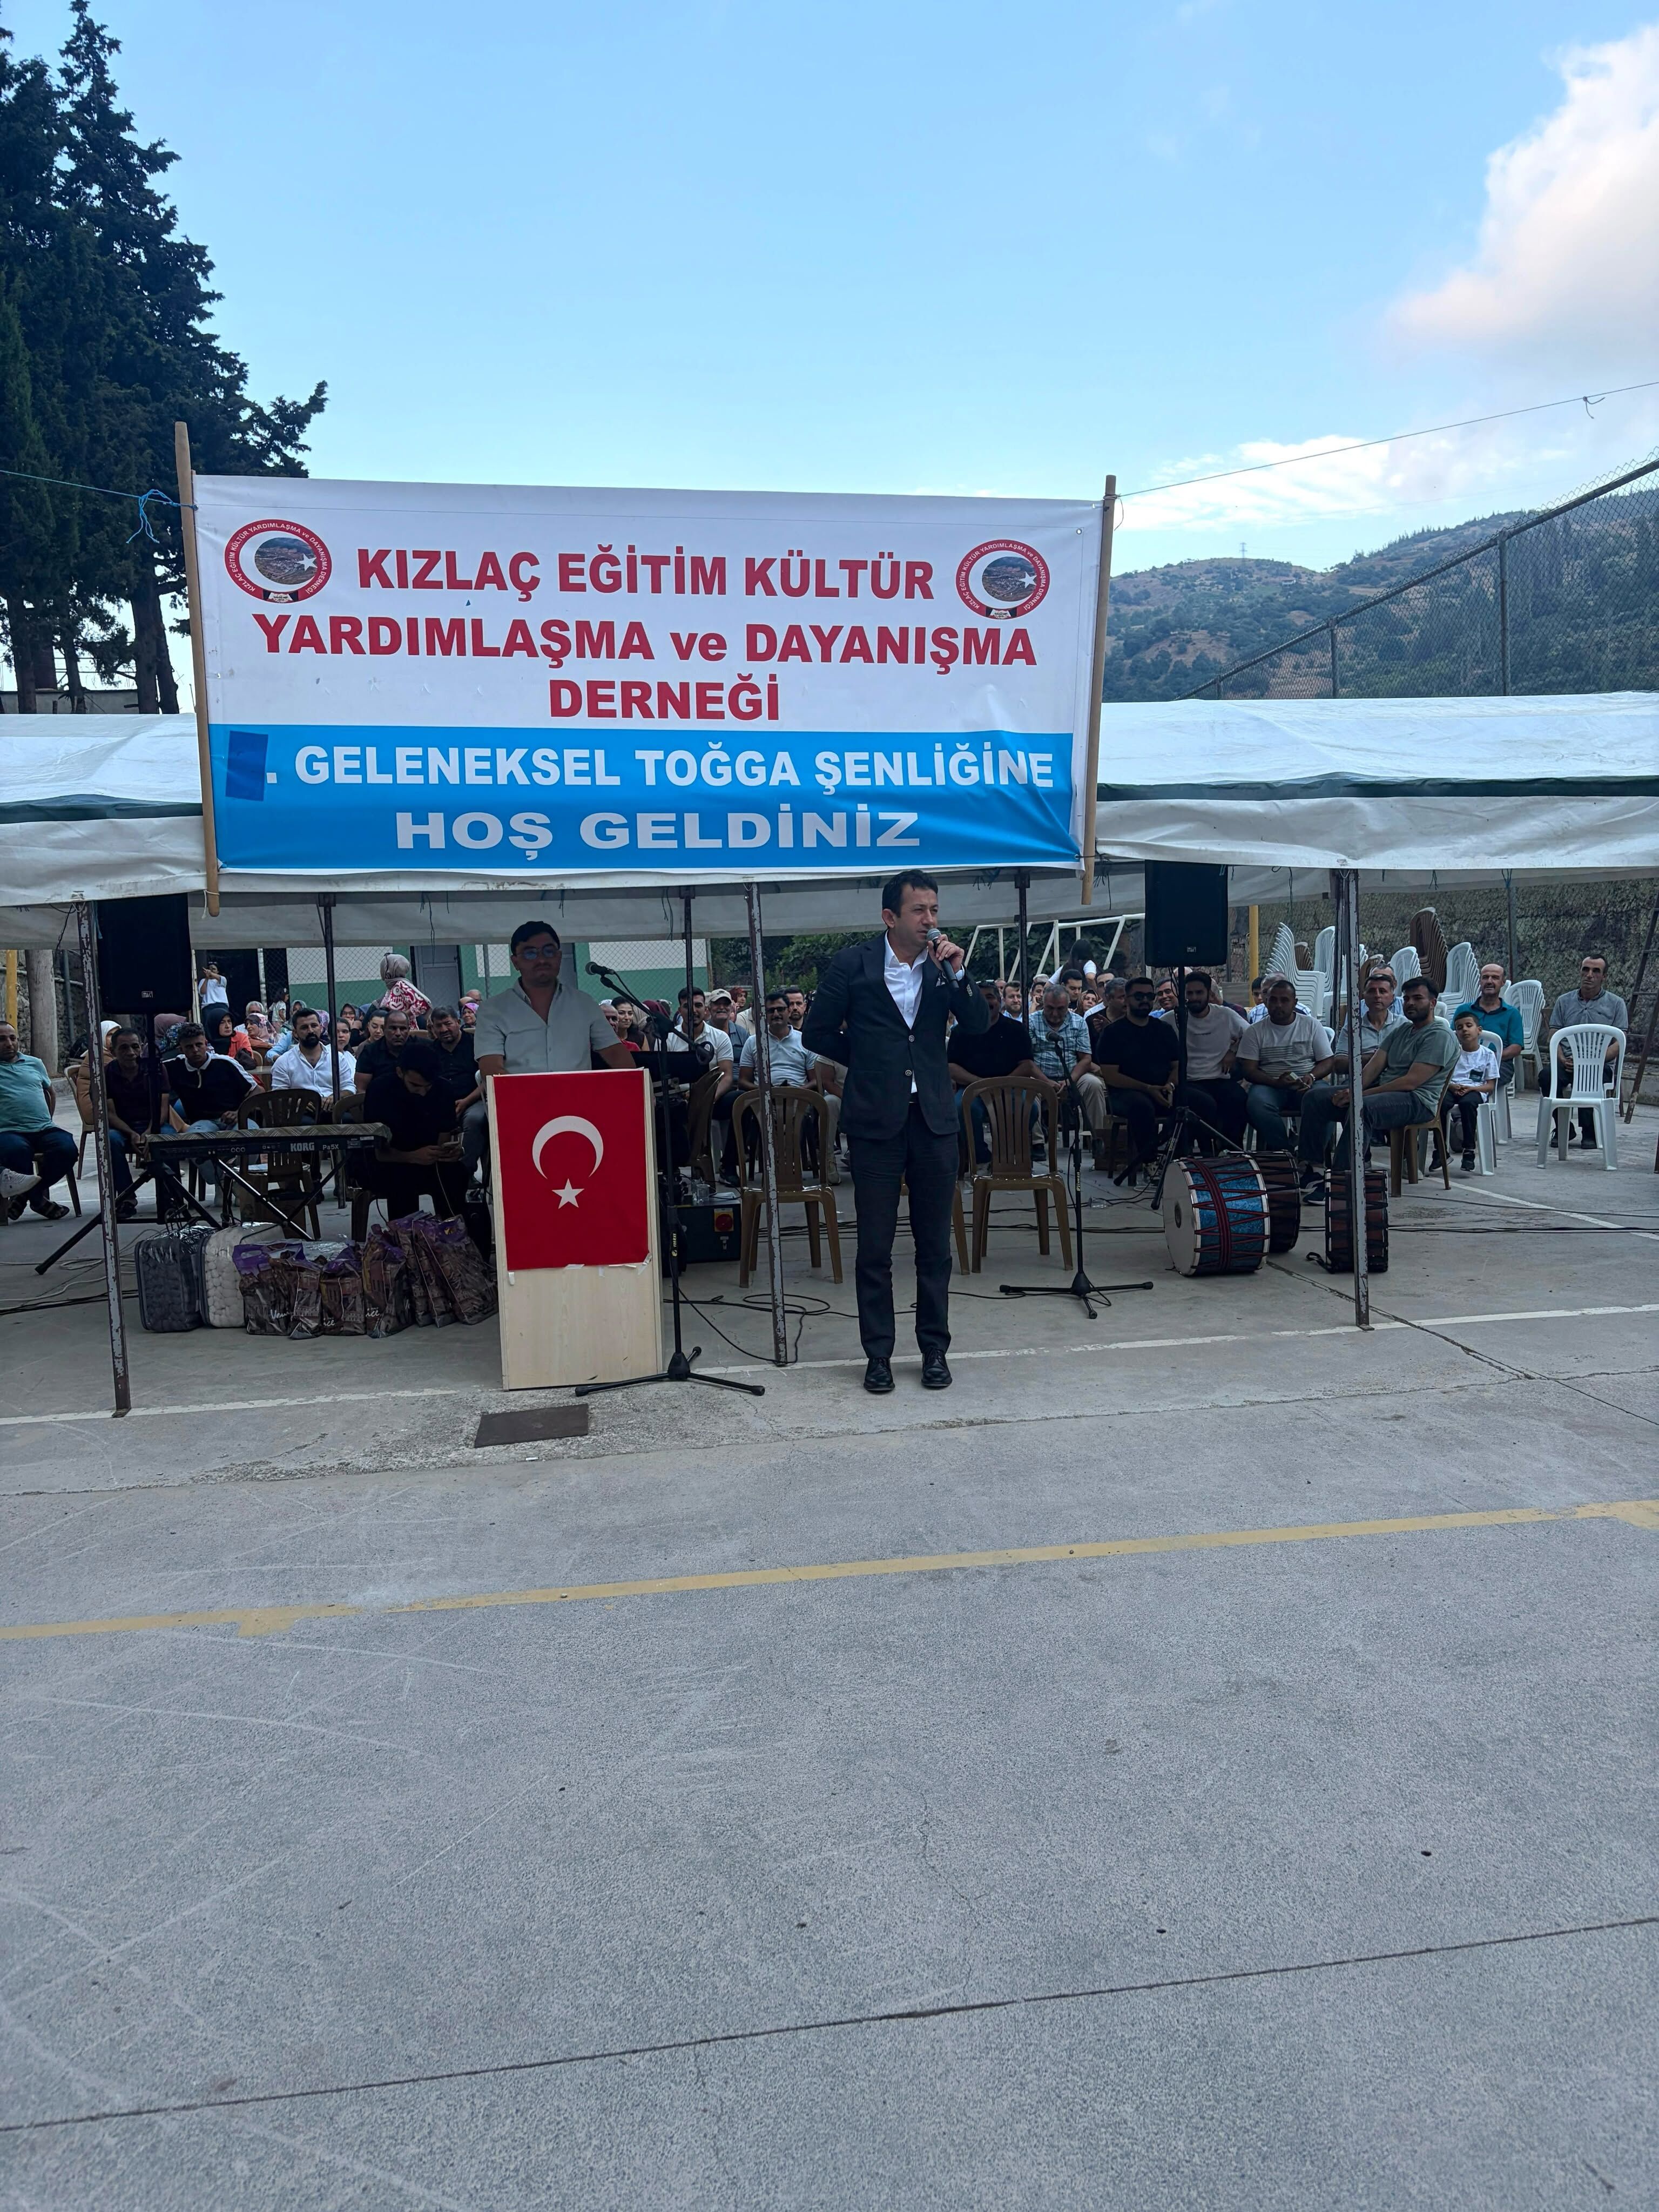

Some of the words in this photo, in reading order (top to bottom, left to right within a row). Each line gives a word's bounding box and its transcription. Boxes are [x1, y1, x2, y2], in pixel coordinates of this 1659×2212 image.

[235, 573, 256, 592] KIZLAÇ
[248, 522, 301, 533] YARDIMLAŞMA
[309, 537, 328, 570] DAYANIŞMA
[358, 549, 541, 602] KIZLAÇ
[559, 544, 725, 594] EĞİTİM
[745, 549, 933, 599] KÜLTÜR
[980, 543, 1027, 552] YARDIMLAŞMA
[252, 613, 655, 668] YARDIMLAŞMA
[671, 633, 726, 660] ve
[746, 624, 1036, 675] DAYANIŞMA
[550, 673, 778, 720] DERNEĞİ
[295, 746, 621, 786] GELENEKSEL
[635, 741, 801, 786] TOĞGA
[815, 742, 1054, 795] ŞENLİĞİNE
[396, 812, 552, 860] HOŞ
[580, 804, 919, 849] GELDİNİZ
[290, 1142, 315, 1152] KORG
